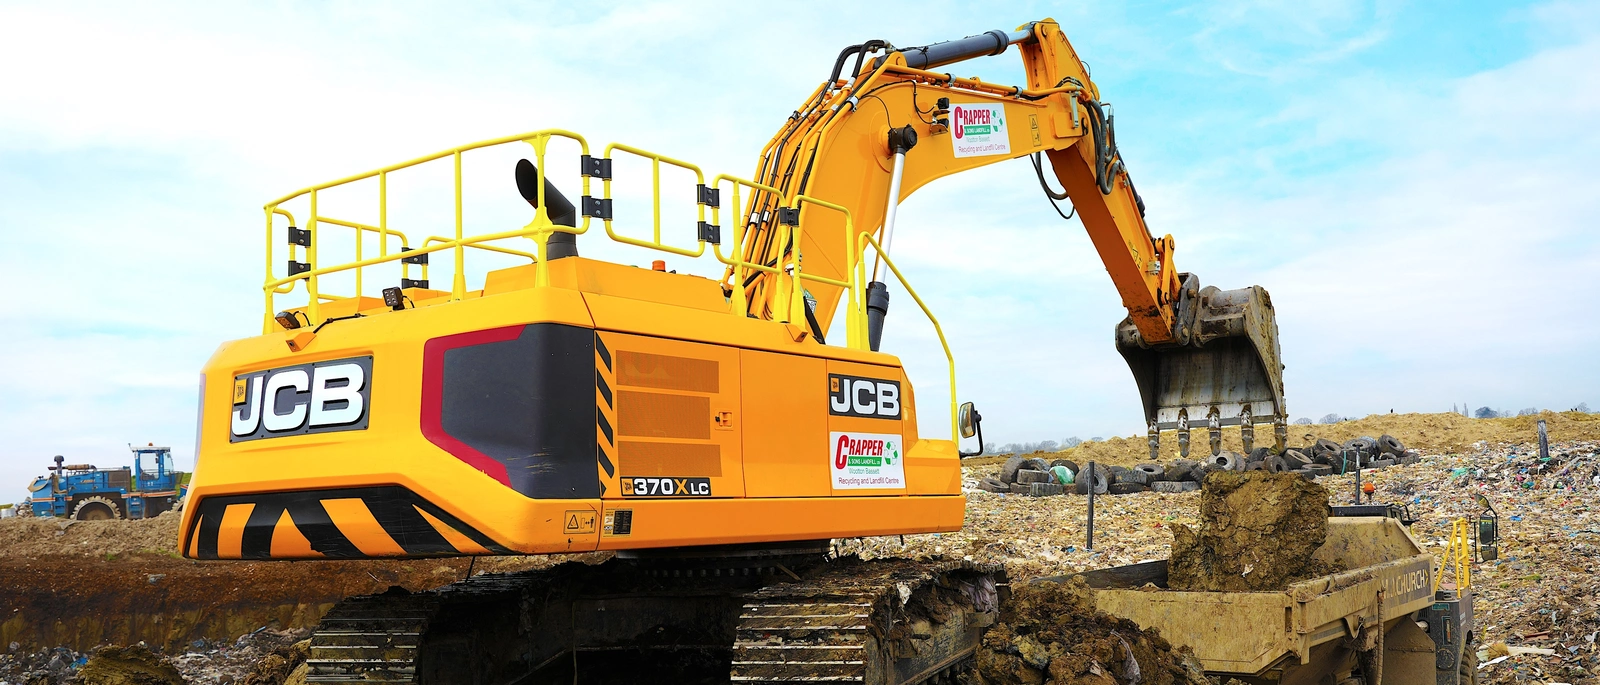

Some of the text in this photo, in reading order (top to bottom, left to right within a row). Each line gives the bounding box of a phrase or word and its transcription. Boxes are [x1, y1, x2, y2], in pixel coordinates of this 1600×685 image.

[954, 106, 990, 139] CRAPPER
[958, 145, 976, 154] Recycling
[983, 143, 995, 151] Landfill
[995, 143, 1006, 151] Centre
[231, 363, 365, 437] JCB
[831, 379, 900, 416] JCB
[836, 435, 884, 469] CRAPPER
[838, 476, 899, 486] Recycling and Landfill Centre
